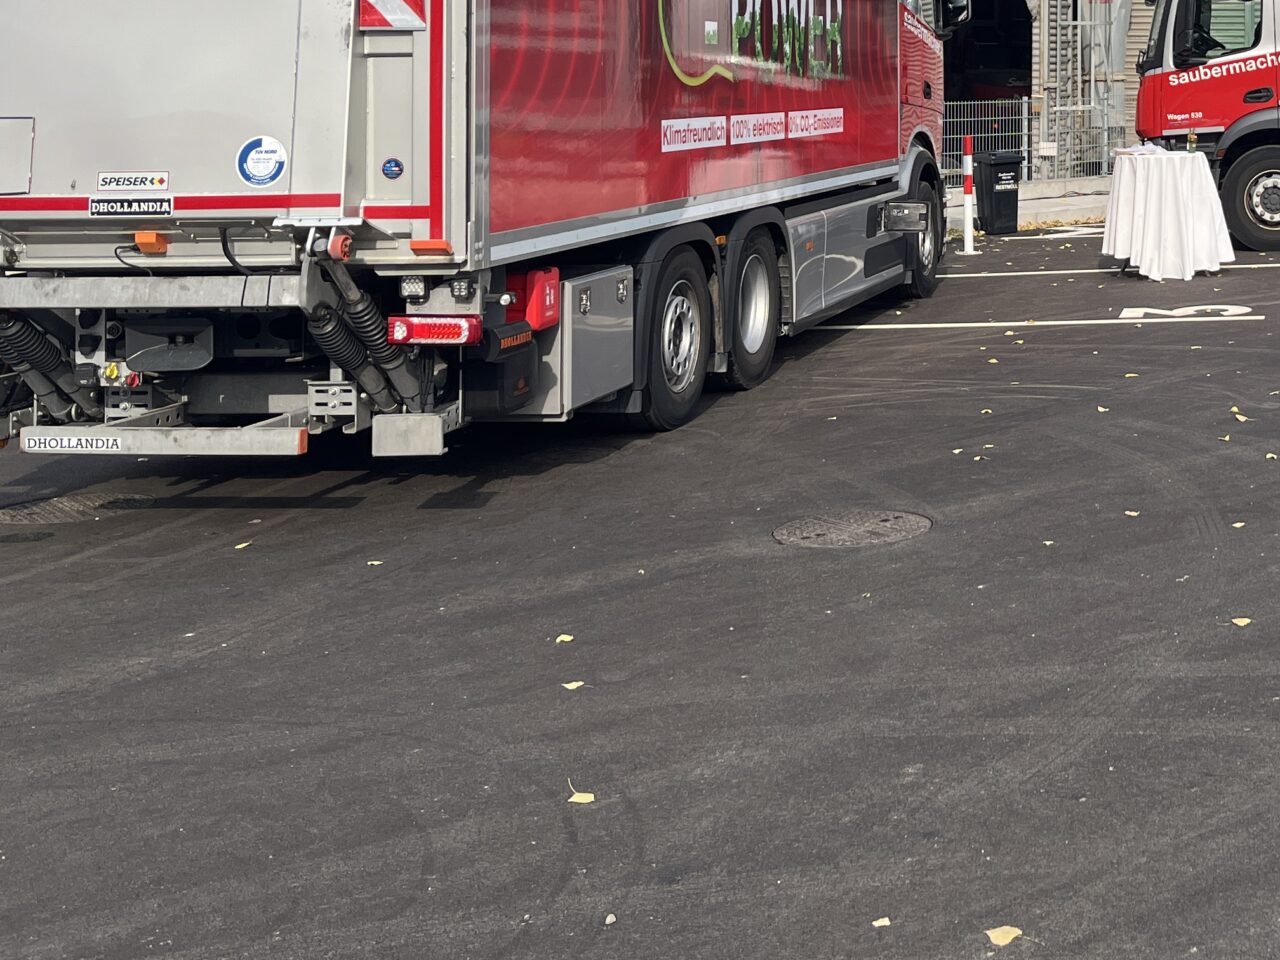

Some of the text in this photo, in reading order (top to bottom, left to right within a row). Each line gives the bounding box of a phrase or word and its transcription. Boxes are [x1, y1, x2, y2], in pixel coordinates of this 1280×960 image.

[662, 120, 725, 146] Klimafreundlich
[731, 119, 751, 140] 100%
[752, 115, 785, 137] elektrisch
[100, 176, 148, 187] SPEISER
[91, 202, 170, 212] DHOLLANDIA
[27, 438, 119, 450] DHOLLANDIA
